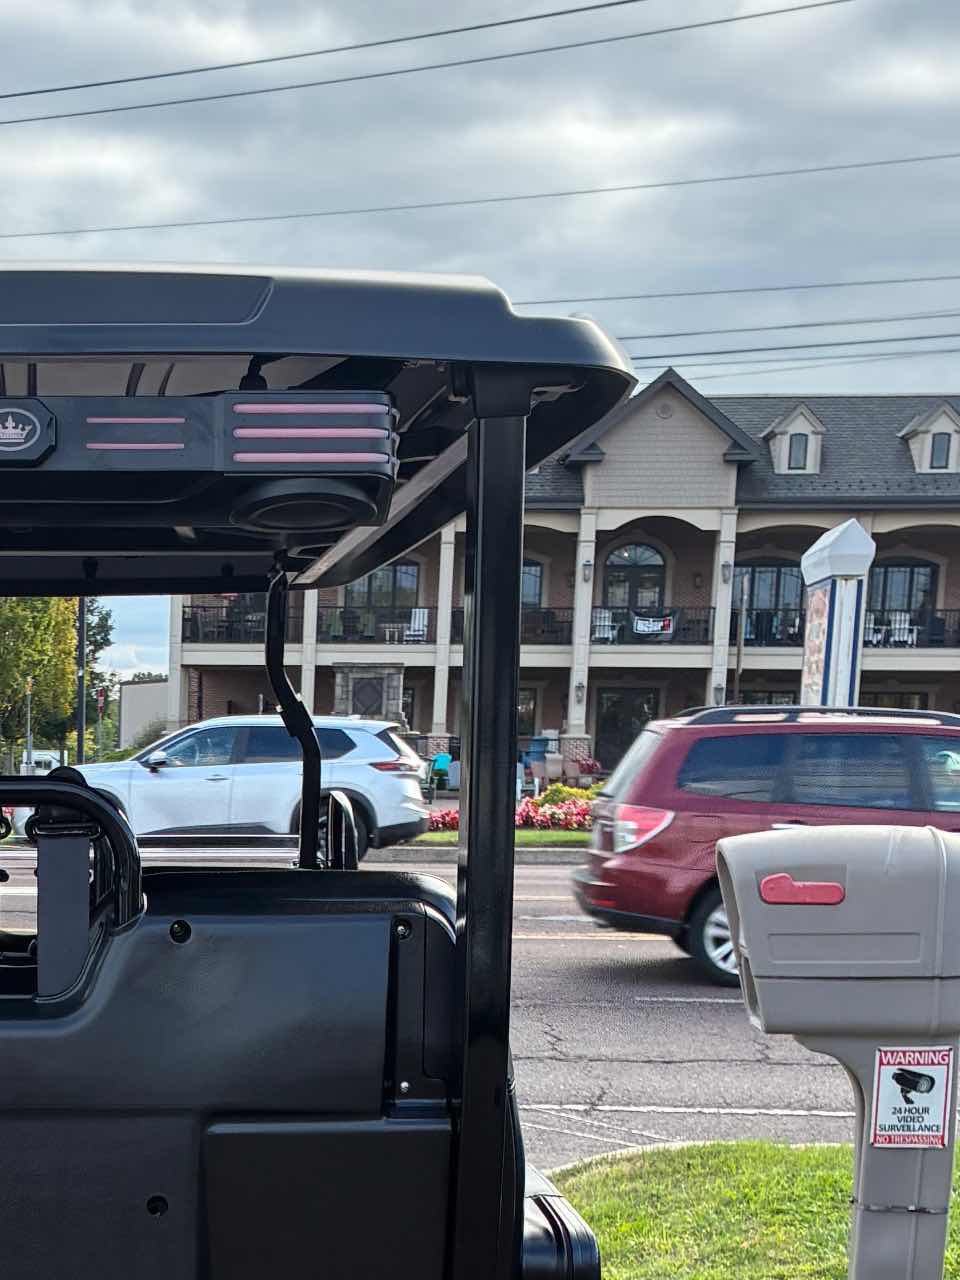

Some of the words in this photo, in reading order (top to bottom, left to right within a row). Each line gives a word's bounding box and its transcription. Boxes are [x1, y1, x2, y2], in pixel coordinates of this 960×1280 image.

[880, 1051, 949, 1065] WARNING
[891, 1106, 903, 1115] 24
[903, 1106, 930, 1115] HOUR
[897, 1115, 924, 1123] VIDEO
[878, 1124, 941, 1132] SURVEILLANCE
[876, 1135, 890, 1144] NO
[891, 1135, 942, 1145] TRESPASSING
